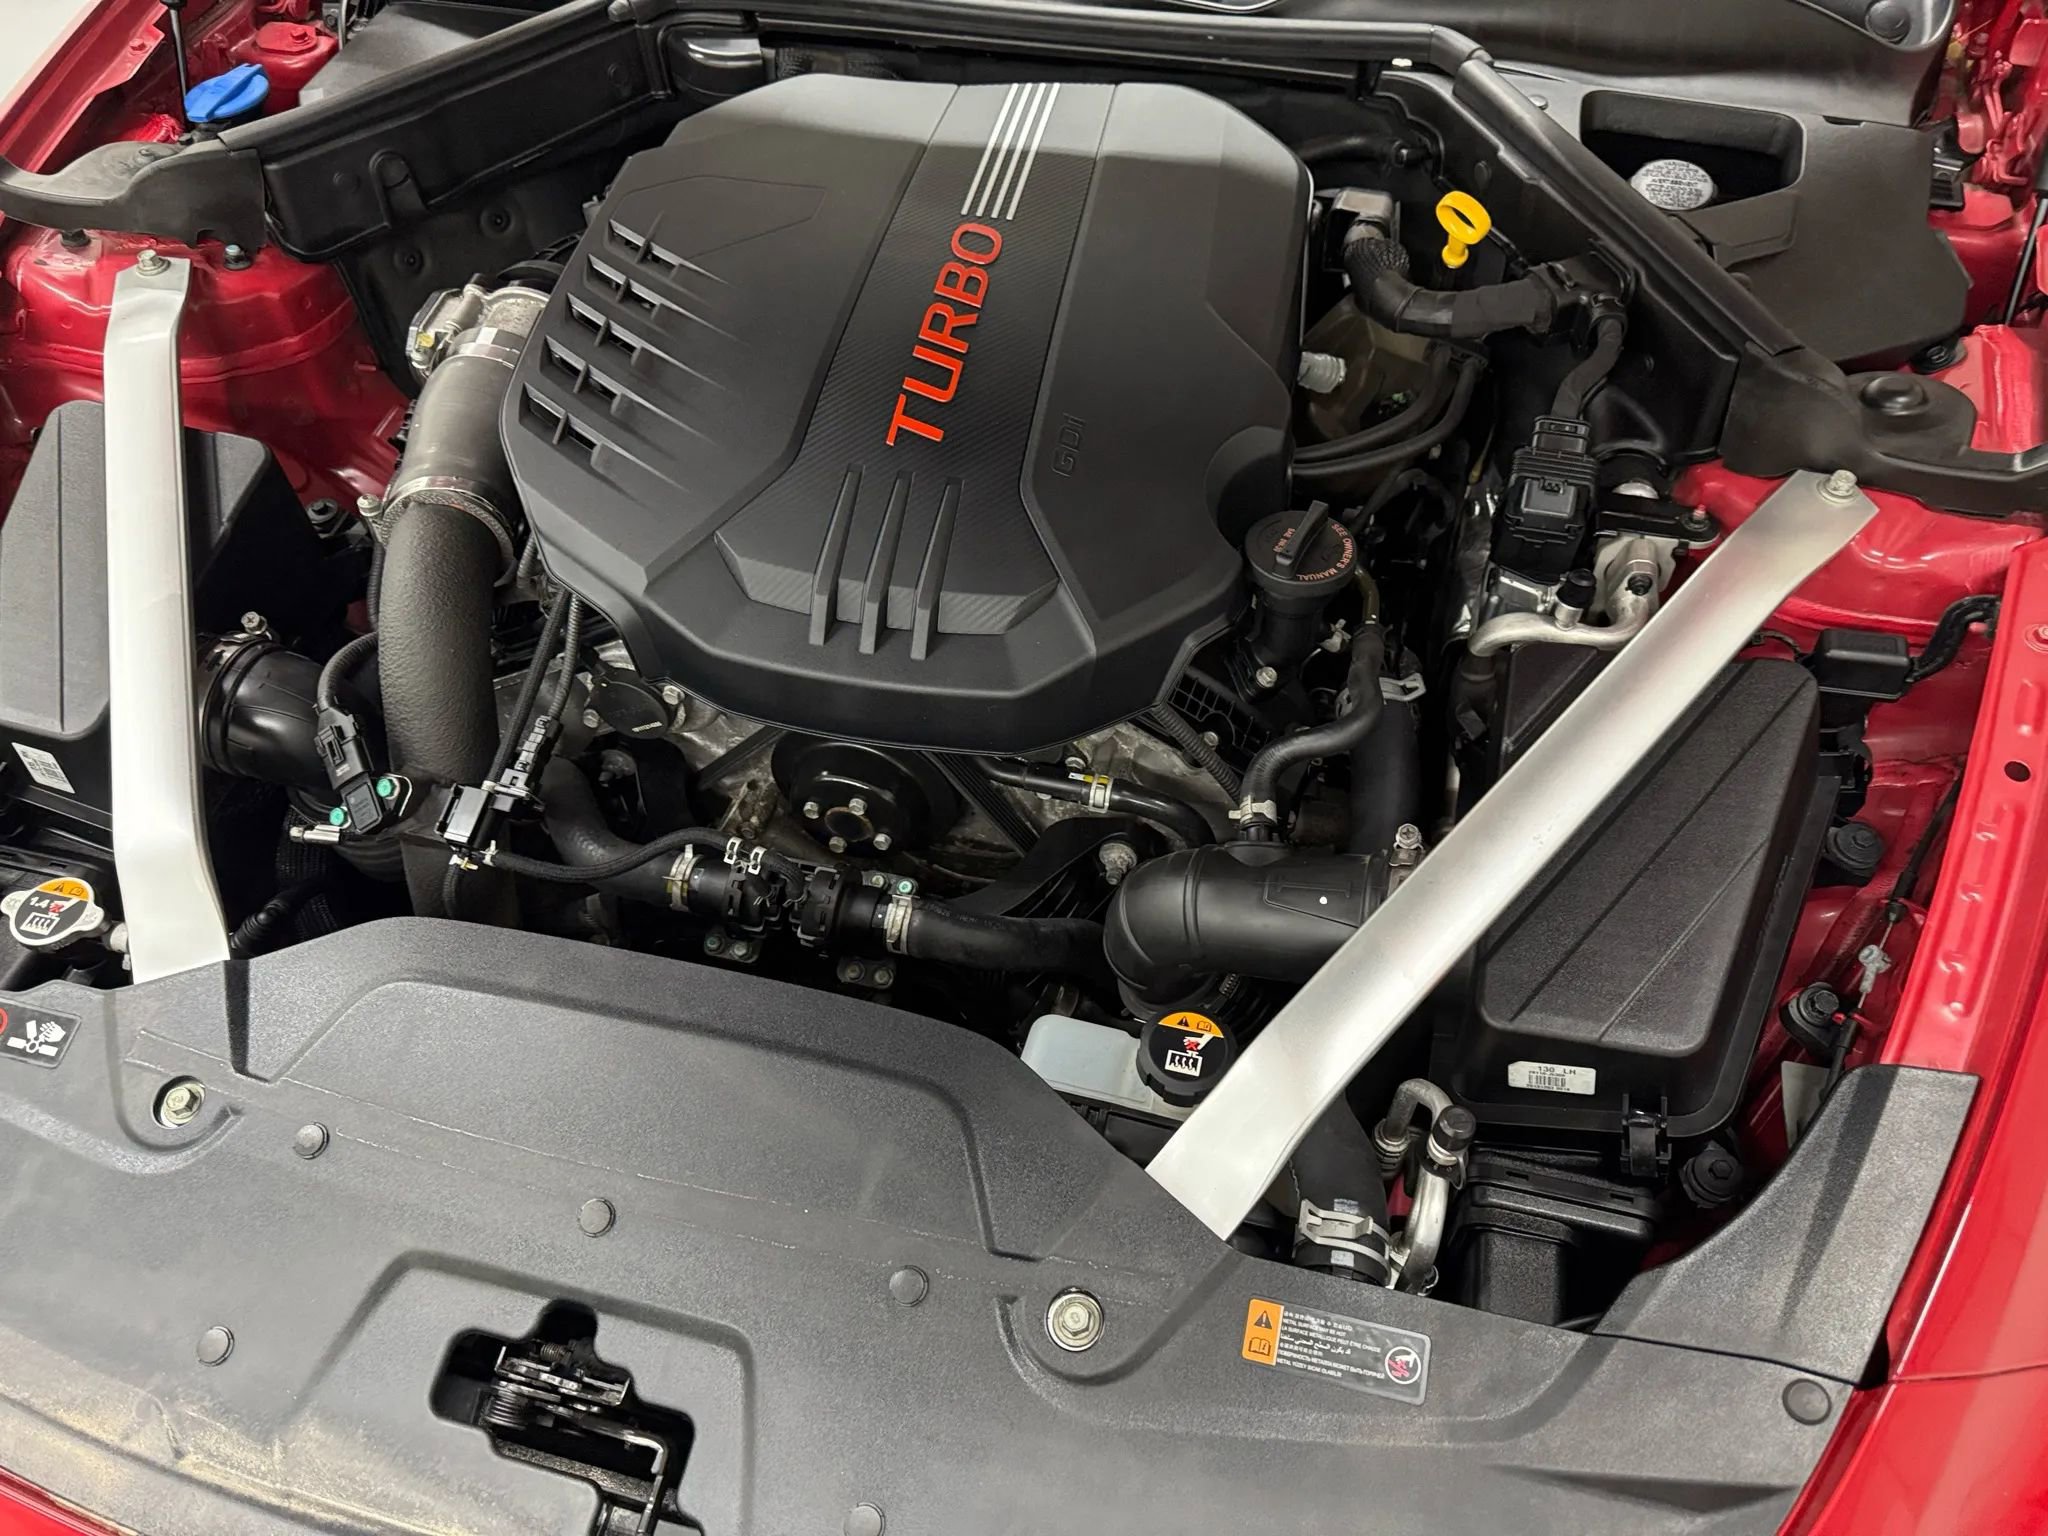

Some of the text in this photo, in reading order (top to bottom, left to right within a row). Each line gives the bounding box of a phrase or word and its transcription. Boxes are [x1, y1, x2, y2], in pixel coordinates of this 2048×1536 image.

[886, 223, 1003, 446] TURBO
[1331, 523, 1348, 537] SEE
[1296, 567, 1338, 581] MANUAL
[29, 896, 51, 909] 1.4
